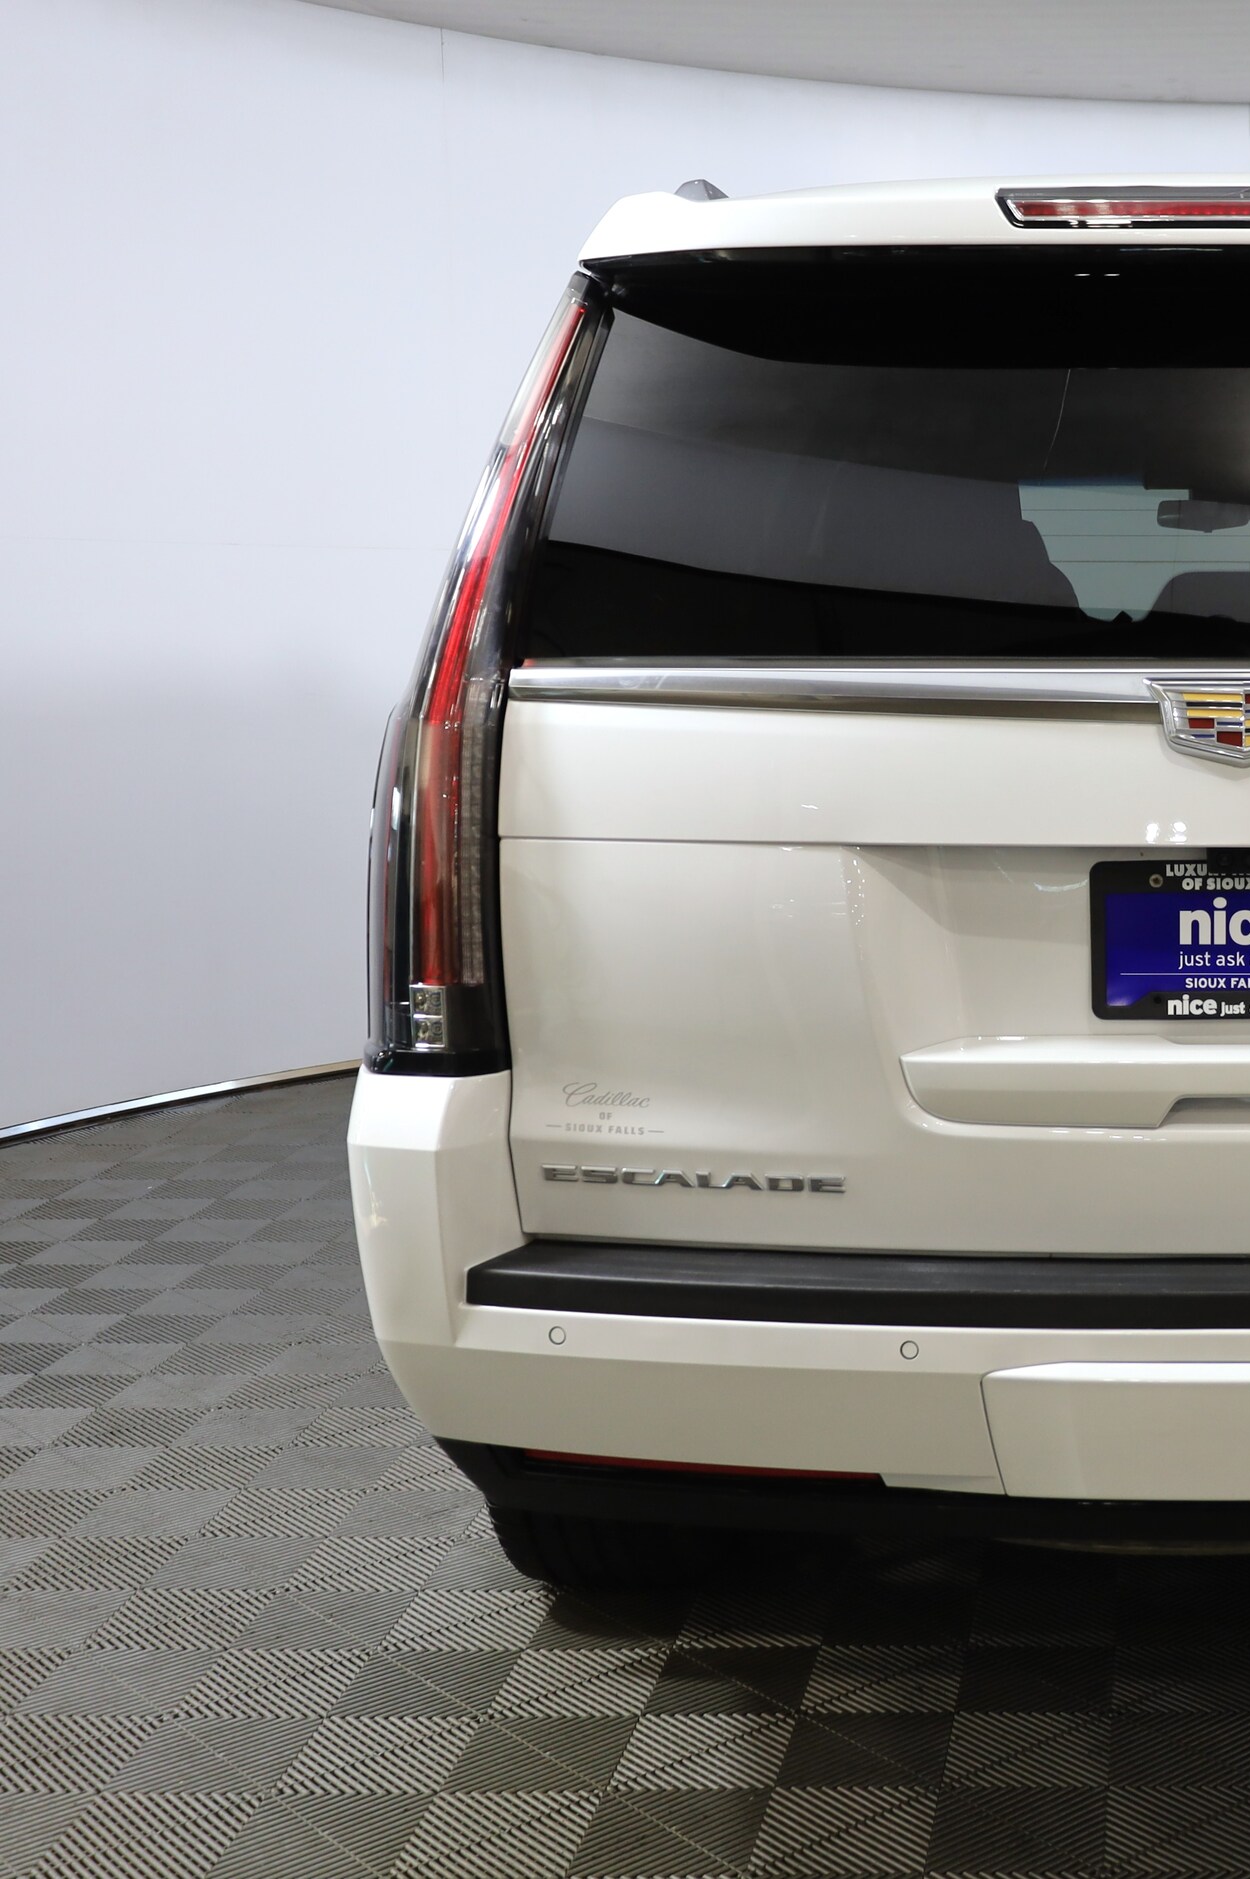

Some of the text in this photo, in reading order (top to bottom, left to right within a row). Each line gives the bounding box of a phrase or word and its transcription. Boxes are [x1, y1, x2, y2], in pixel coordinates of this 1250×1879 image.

[1165, 863, 1226, 876] LUXU
[1182, 877, 1203, 890] OF
[1178, 951, 1211, 970] just
[1215, 951, 1246, 967] ask
[1185, 977, 1226, 989] SIOUX
[1167, 994, 1217, 1015] nice
[1220, 1001, 1246, 1017] just
[562, 1082, 651, 1108] Cadillac
[598, 1112, 613, 1121] OF
[565, 1123, 645, 1135] SIOUX FALLS
[541, 1163, 846, 1194] ESCALADE
